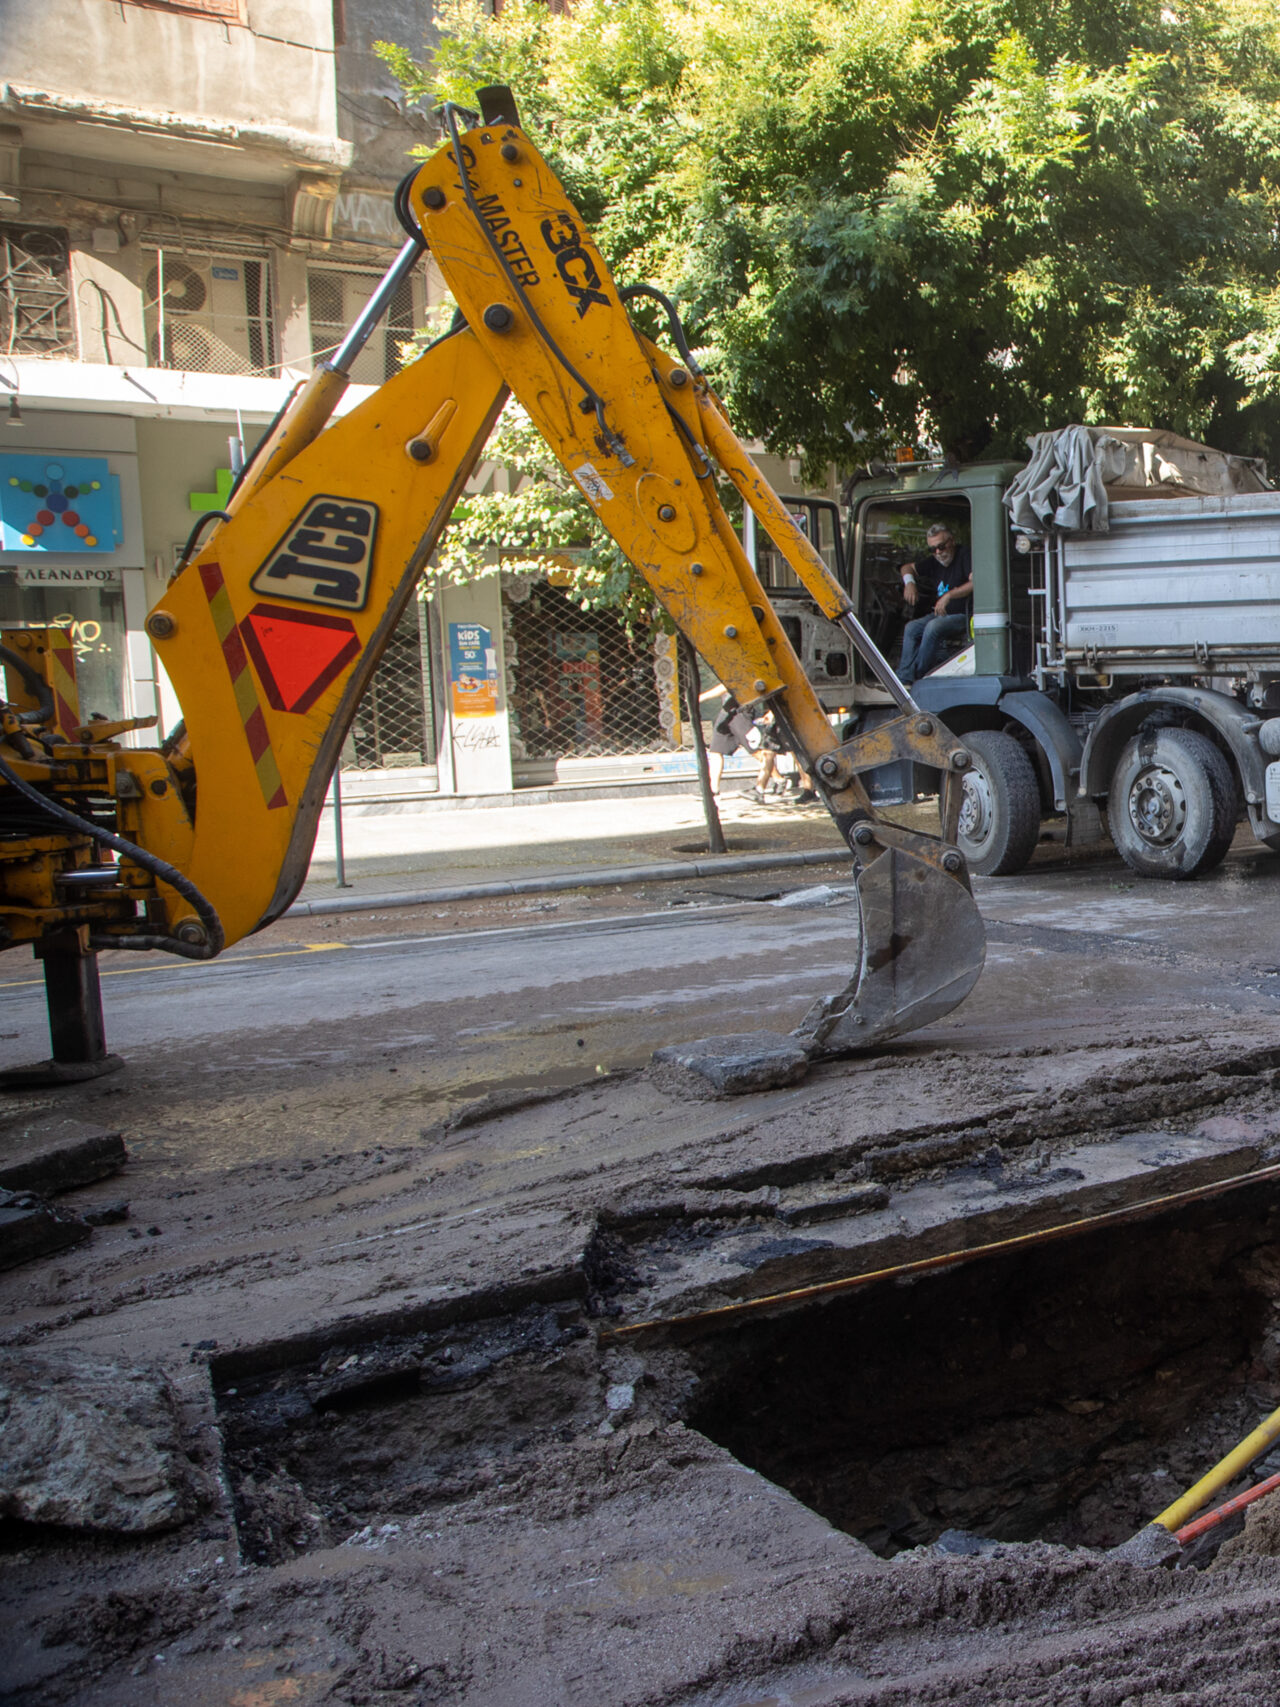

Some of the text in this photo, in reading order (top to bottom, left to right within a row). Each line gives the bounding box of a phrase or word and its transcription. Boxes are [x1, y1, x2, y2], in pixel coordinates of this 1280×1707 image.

[477, 193, 541, 288] MASTER
[541, 214, 612, 319] 3CX
[25, 568, 116, 581] ΛΕΑΝΔΡΟΣ
[266, 502, 371, 603] JCB
